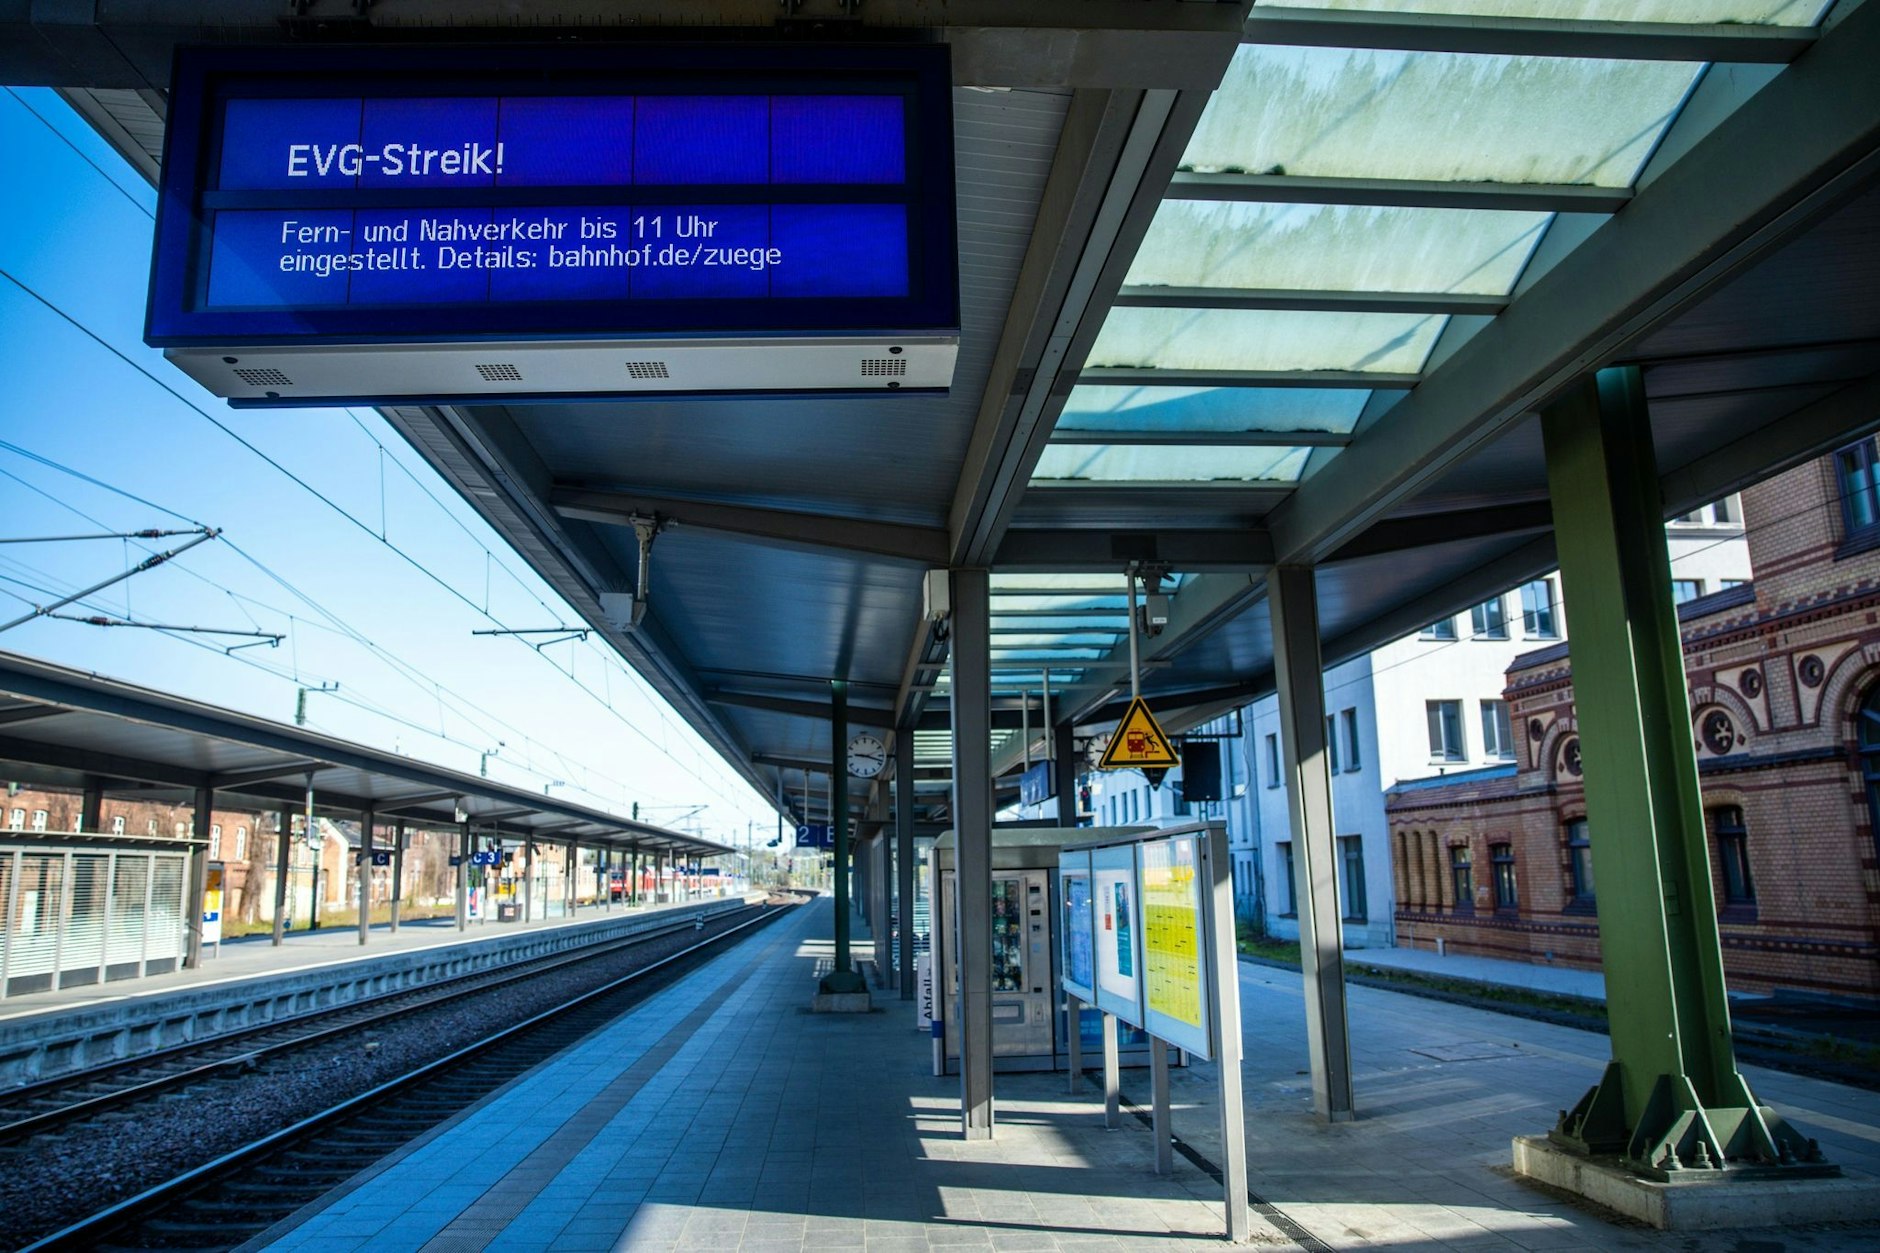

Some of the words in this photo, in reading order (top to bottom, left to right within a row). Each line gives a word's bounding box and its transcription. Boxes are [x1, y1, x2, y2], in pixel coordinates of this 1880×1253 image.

[288, 143, 503, 175] EVG-Streik!
[281, 221, 350, 243] Fern-
[364, 220, 407, 241] und
[421, 218, 567, 240] Nahverkehr
[581, 217, 616, 238] bis
[634, 217, 660, 237] 11
[677, 216, 718, 237] Uhr
[279, 248, 425, 274] eingestellt.
[439, 246, 536, 268] Details:
[549, 244, 782, 271] bahnhof.de/zuege
[798, 826, 810, 843] 2
[377, 853, 386, 864] C
[473, 852, 482, 864] C
[487, 851, 496, 863] 3
